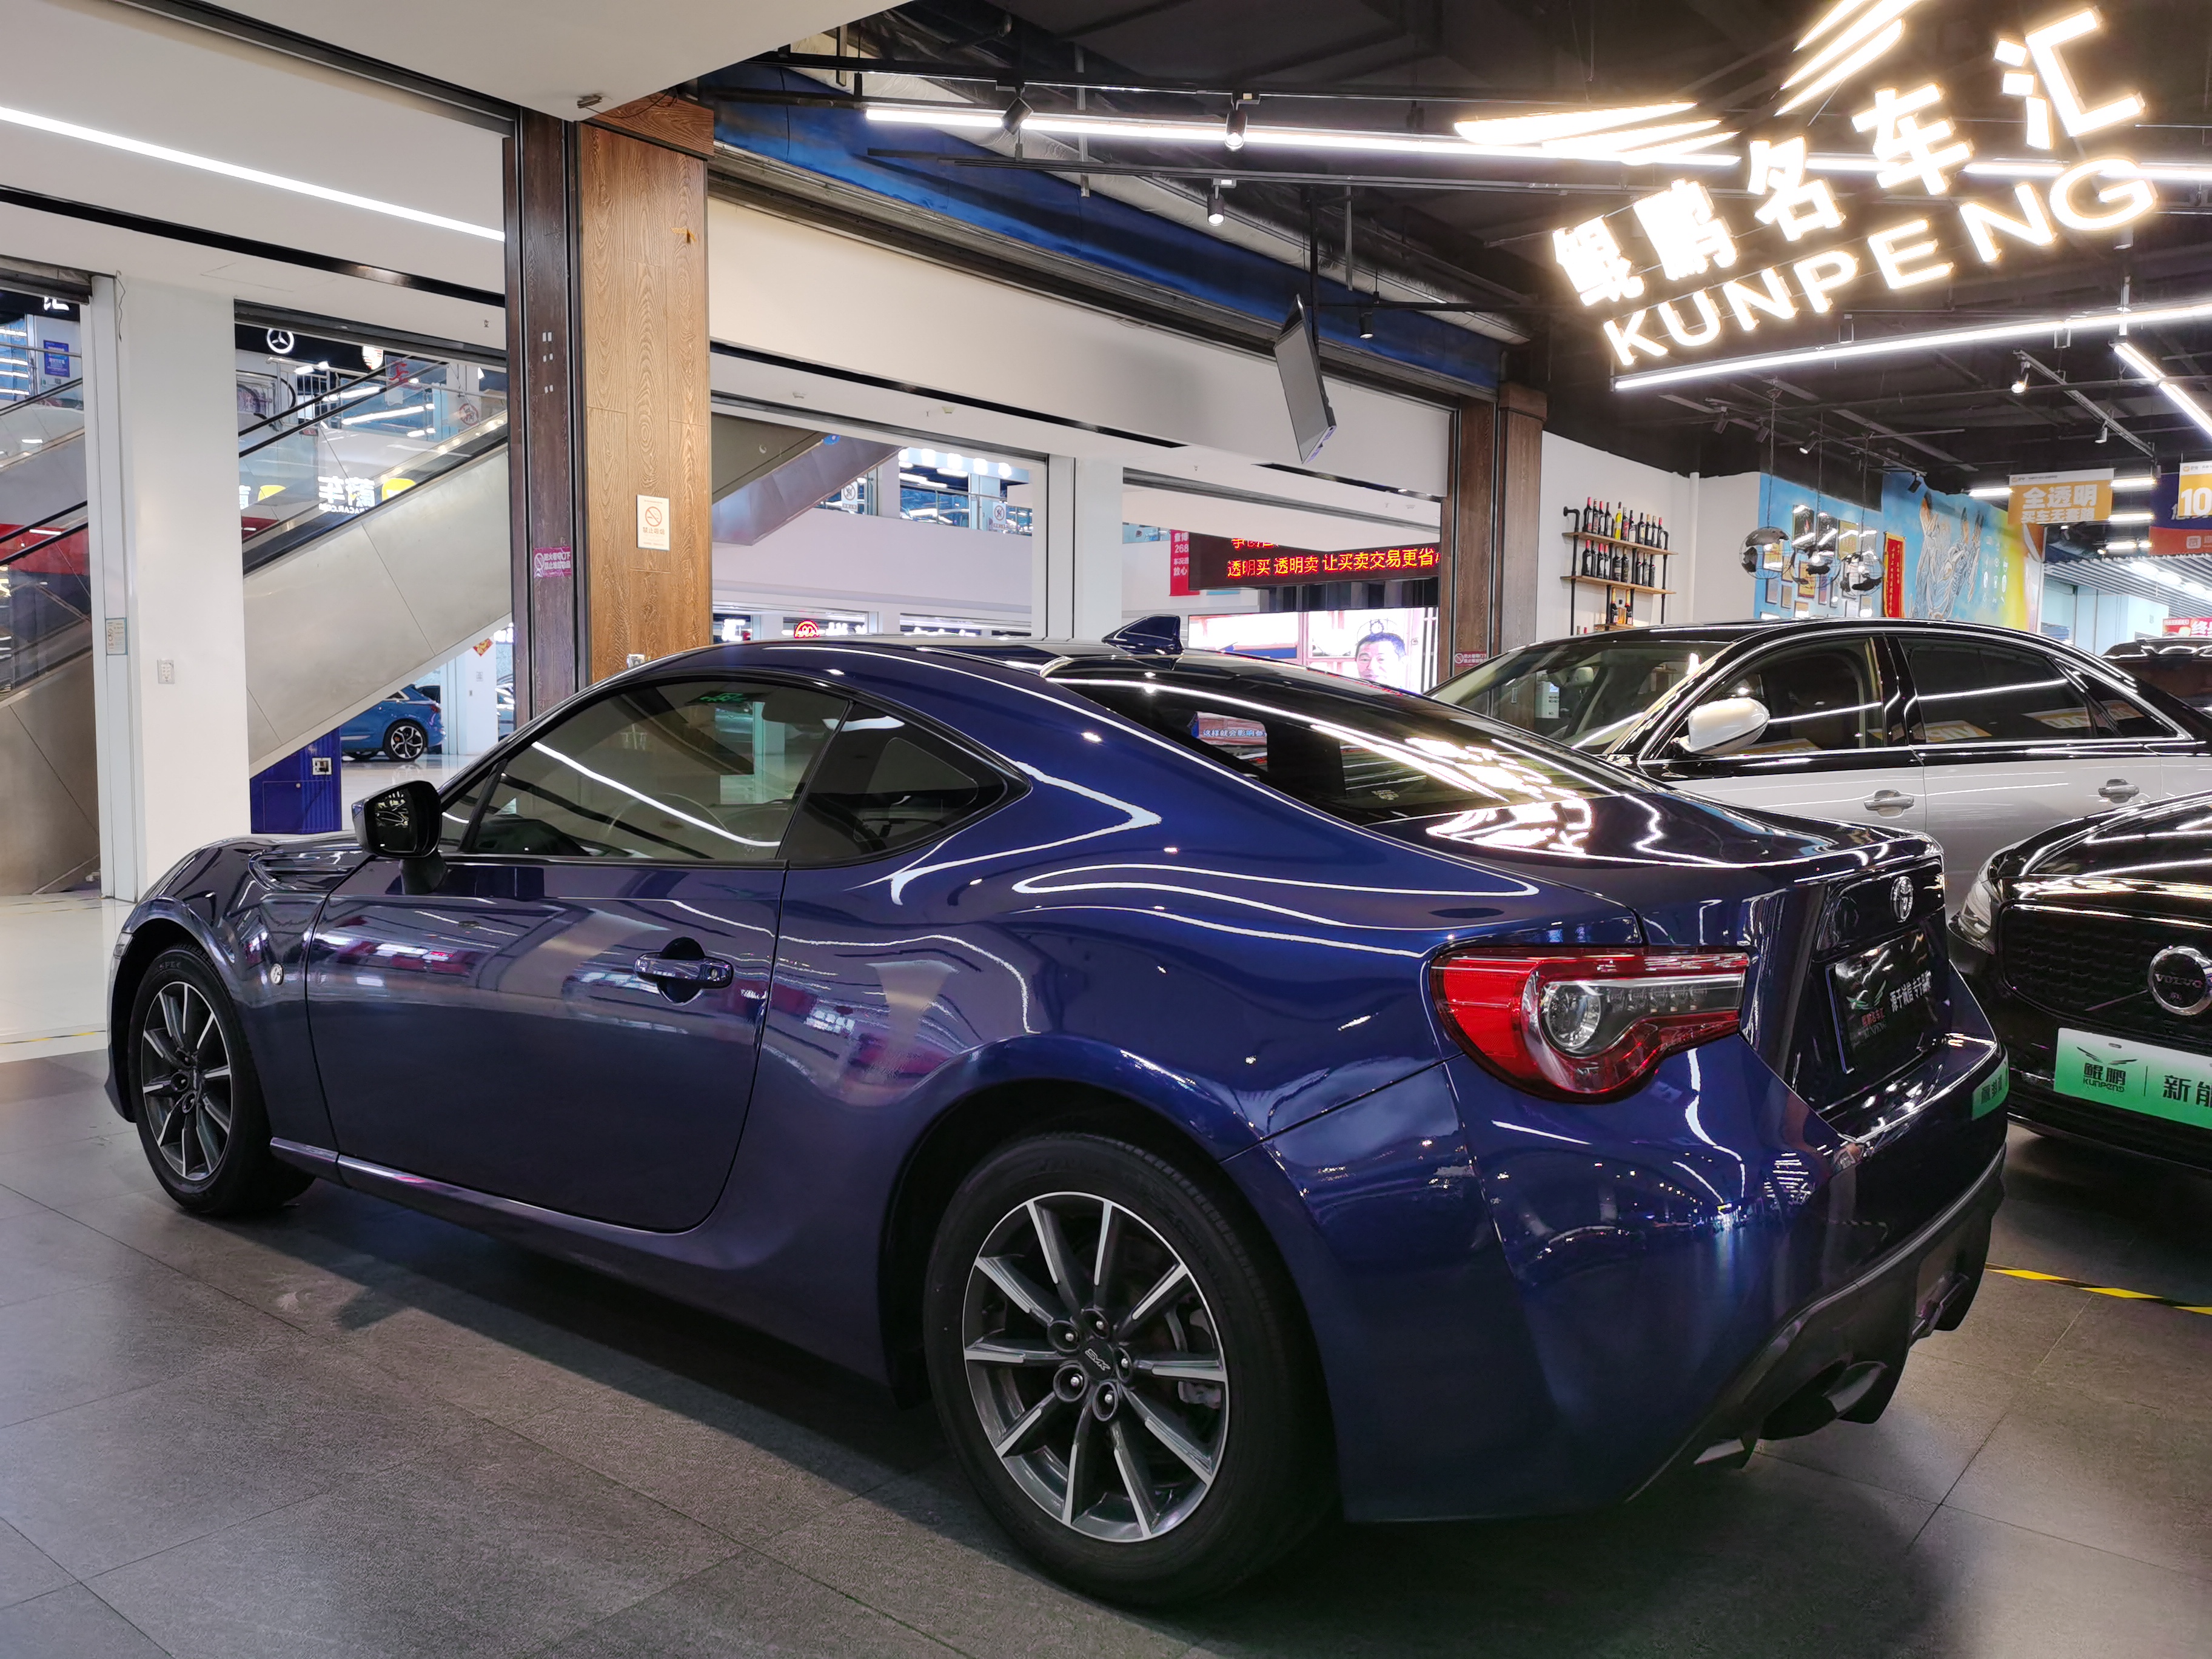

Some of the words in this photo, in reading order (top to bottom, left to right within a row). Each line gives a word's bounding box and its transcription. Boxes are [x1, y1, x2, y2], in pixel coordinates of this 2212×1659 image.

[1551, 6, 2145, 307] 鲲鹏名车汇
[1602, 155, 2159, 367] KUNPENG
[2023, 484, 2097, 509] 全透明
[1175, 544, 1188, 554] 268
[1173, 566, 1188, 577] 放心
[1227, 558, 1270, 578] 透明买
[1274, 554, 1319, 575] 透明卖
[2083, 1062, 2127, 1086] 鲲鹏
[2162, 1074, 2212, 1107] 新能
